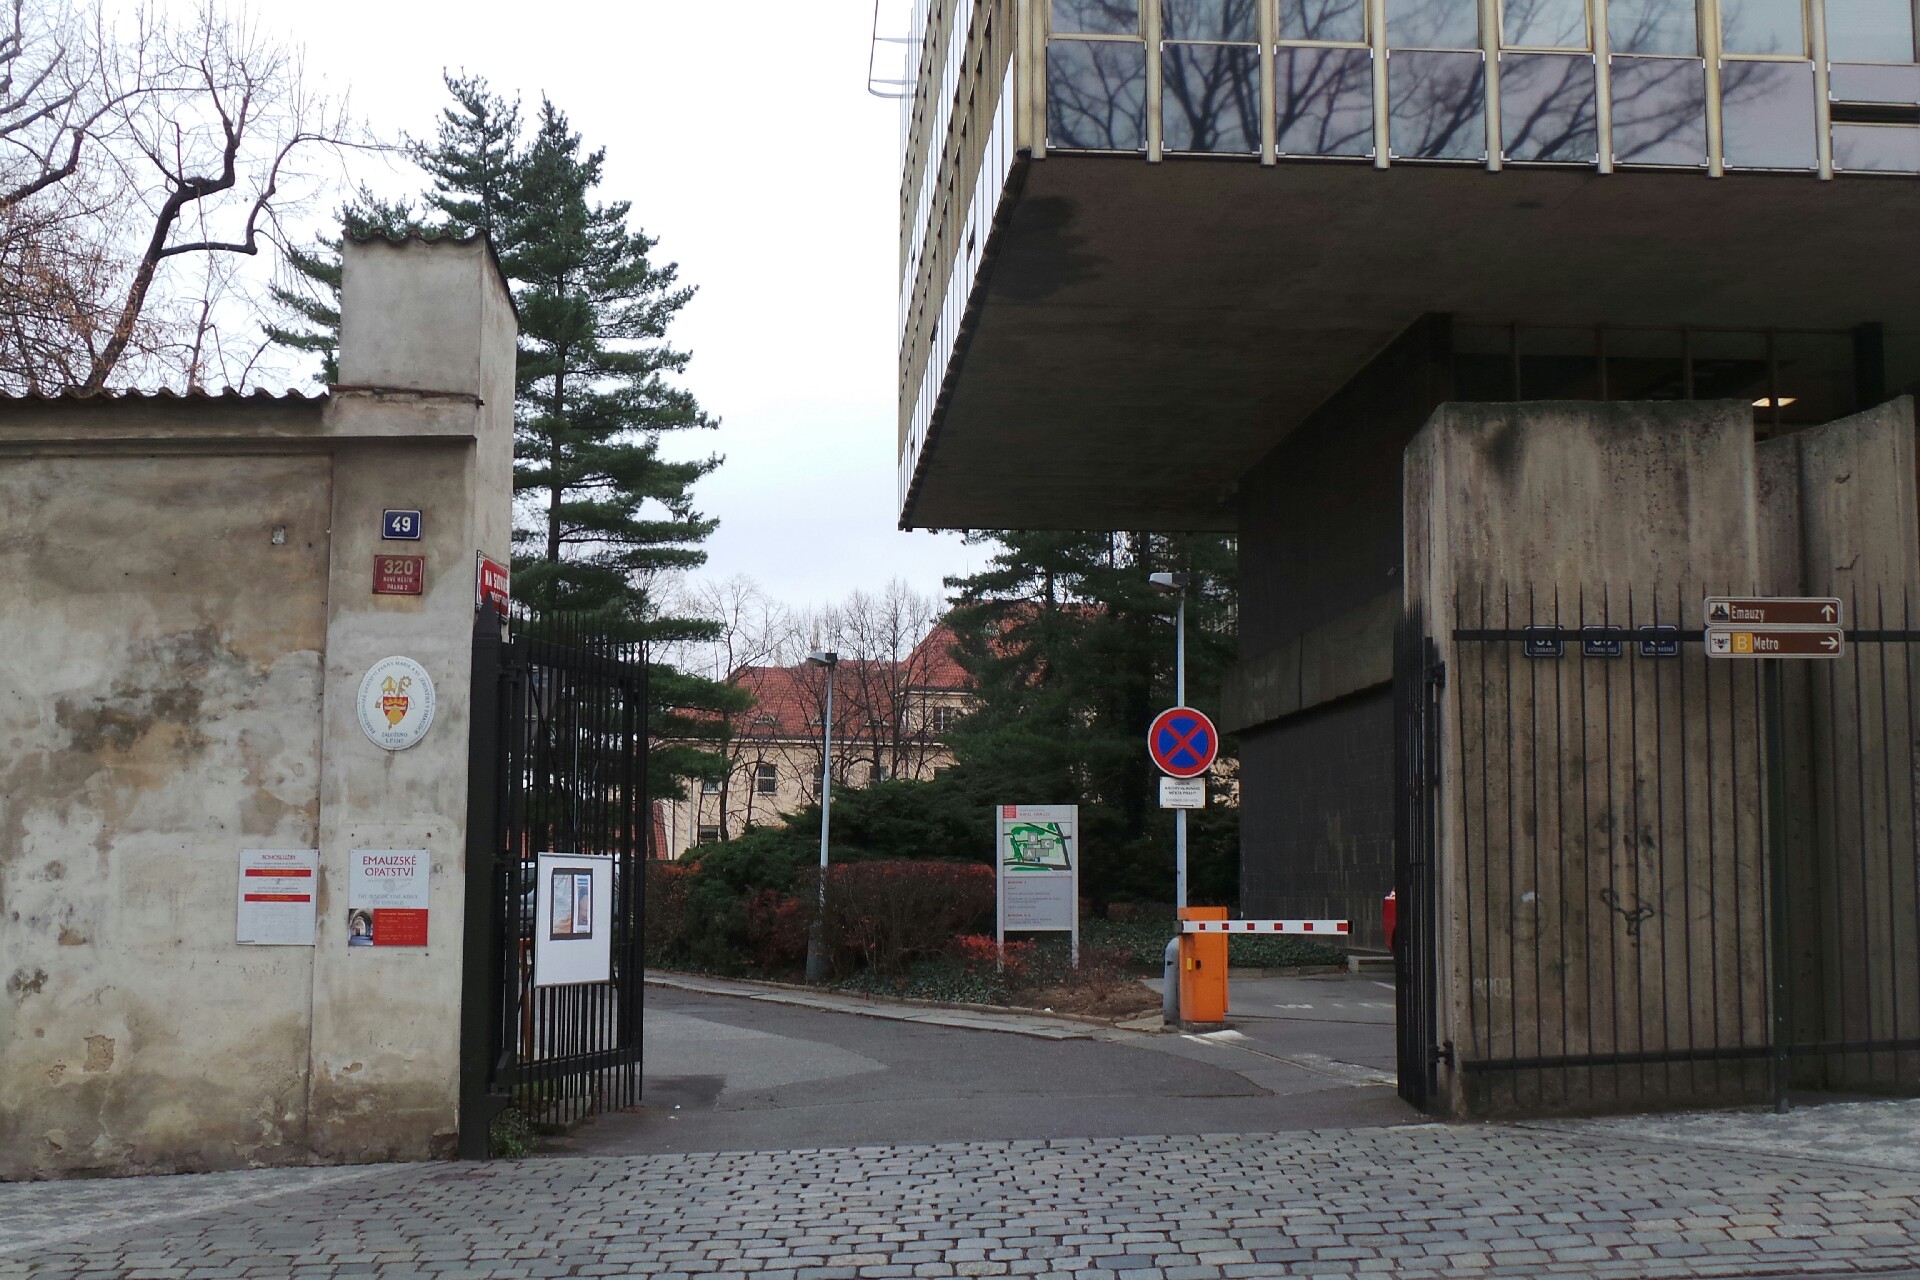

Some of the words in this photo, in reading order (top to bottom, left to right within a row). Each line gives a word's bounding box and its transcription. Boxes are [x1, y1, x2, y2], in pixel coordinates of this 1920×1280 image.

[391, 516, 411, 532] 49
[384, 560, 414, 575] 320
[1731, 605, 1765, 622] Emauzy
[1737, 636, 1748, 650] B
[1754, 637, 1779, 650] Metro
[363, 855, 417, 865] EMAUZSKÉ
[365, 866, 414, 876] OPATSTVÍ
